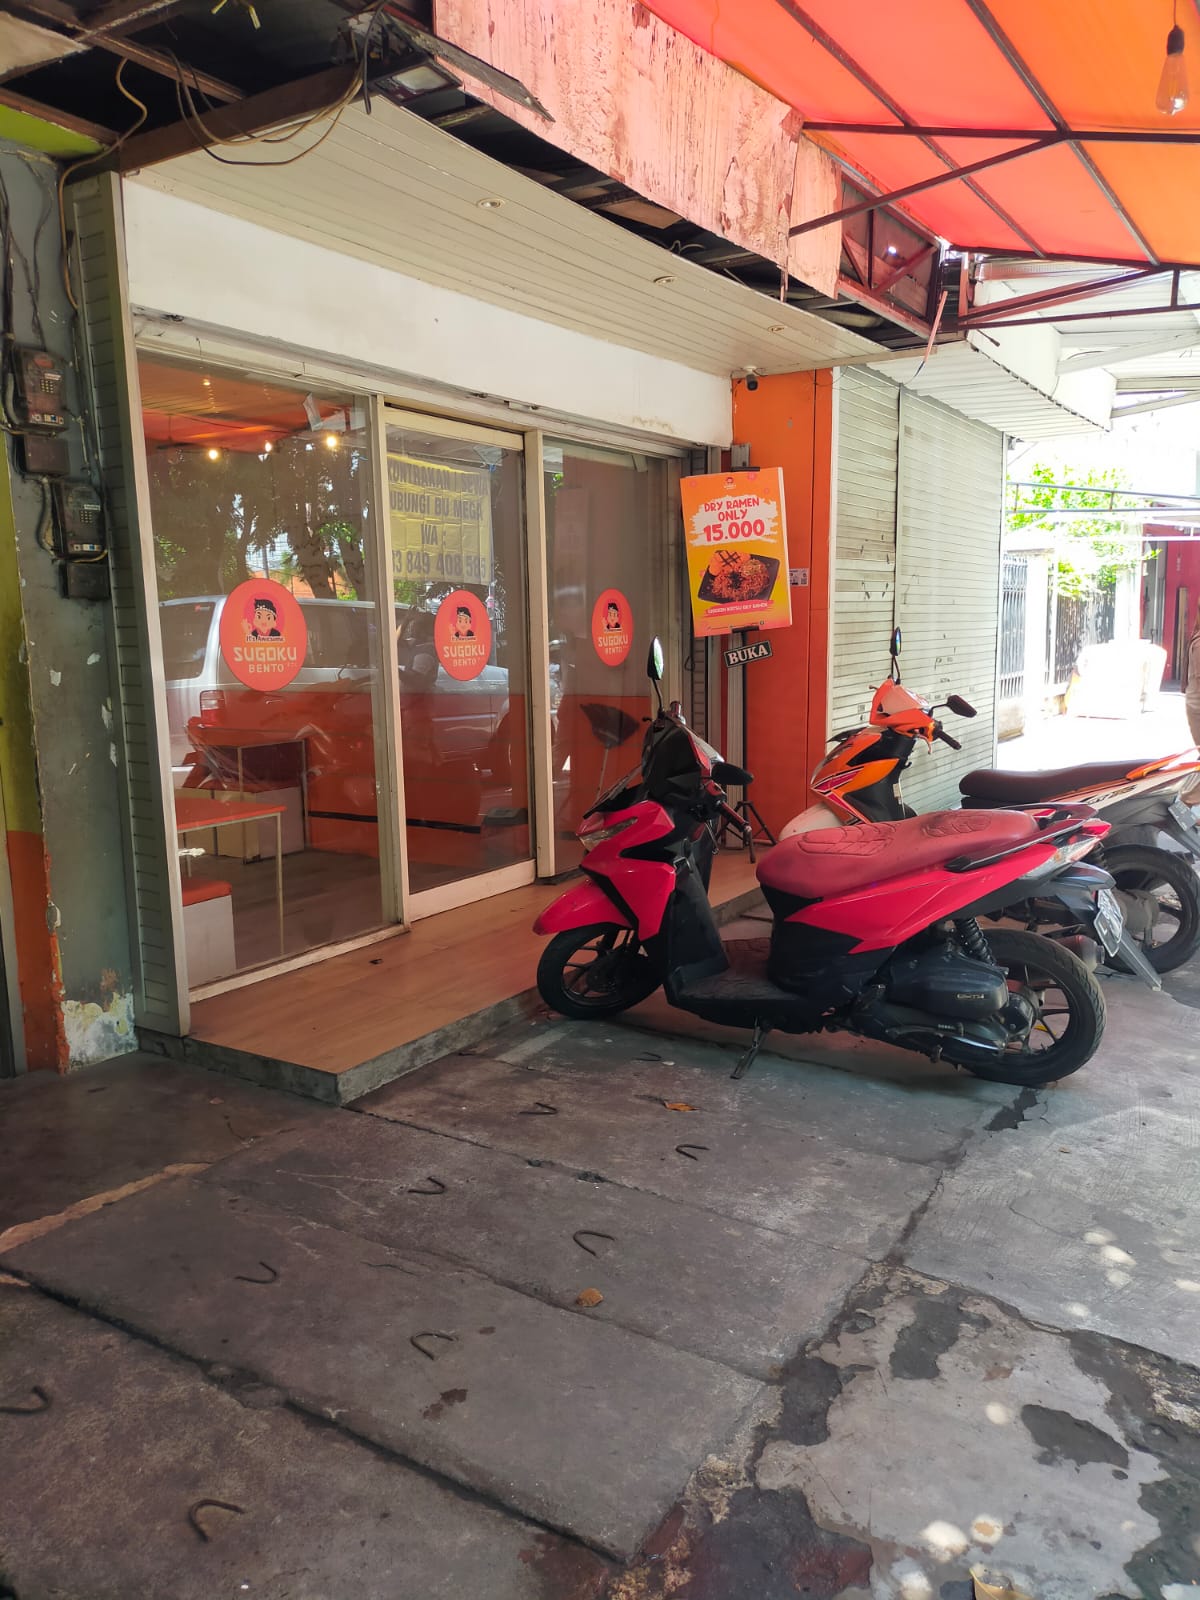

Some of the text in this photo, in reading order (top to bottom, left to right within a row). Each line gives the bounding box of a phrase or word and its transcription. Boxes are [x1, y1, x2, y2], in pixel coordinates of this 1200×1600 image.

[434, 496, 449, 517] BU
[453, 499, 483, 521] MEGA
[704, 497, 760, 513] DRY RAMEN
[717, 509, 748, 522] ONLY
[421, 524, 438, 545] WA
[703, 519, 765, 542] 15.000
[406, 550, 430, 575] 849
[436, 552, 463, 577] 408
[598, 634, 628, 647] SUGOKU
[233, 646, 297, 662] SUGOKU
[443, 644, 485, 658] SUGOKU
[605, 646, 623, 655] BENTO
[728, 644, 769, 666] BUKA
[249, 663, 284, 673] BENTO
[453, 657, 477, 667] BENTO
